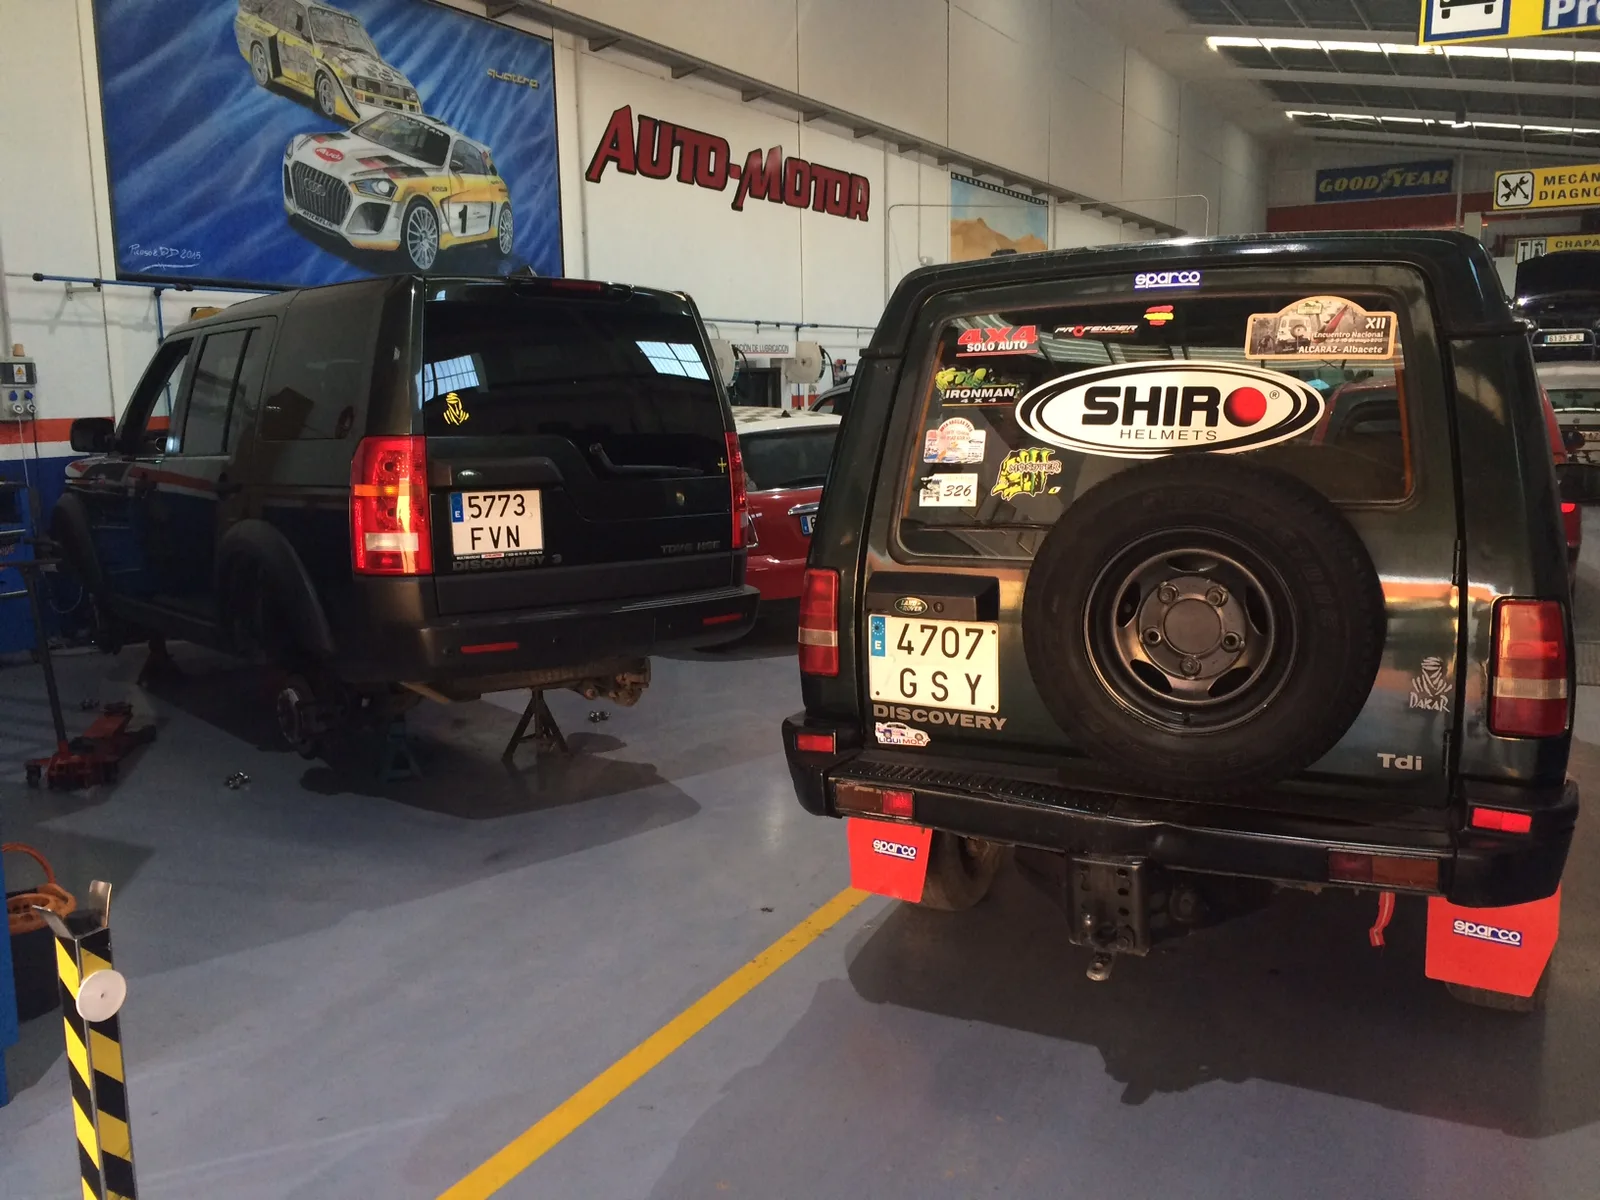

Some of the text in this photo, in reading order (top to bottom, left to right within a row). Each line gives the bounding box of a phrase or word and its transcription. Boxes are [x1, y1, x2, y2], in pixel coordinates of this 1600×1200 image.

[487, 68, 539, 88] quattro
[316, 147, 342, 161] Audi
[585, 104, 870, 222] AUTO-MOTOR
[1543, 171, 1600, 186] MECÁN
[302, 210, 334, 229] MICHELIN
[458, 204, 468, 234] 1
[1135, 271, 1200, 288] sparco
[1054, 324, 1139, 337] PROFENDER
[1365, 317, 1386, 329] XII
[957, 325, 1039, 346] 4X4
[1314, 331, 1351, 339] Encuentro
[966, 340, 1028, 352] SOLO AUTO
[1343, 345, 1383, 354] Albacete
[945, 387, 1015, 399] IRONMAN
[1081, 386, 1267, 428] SHIRO
[1120, 429, 1217, 441] HELMETS
[944, 484, 972, 497] 326
[468, 494, 525, 518] 5773
[471, 525, 520, 550] FVN
[452, 555, 545, 571] DISCOVERY
[875, 641, 882, 649] E
[897, 623, 984, 660] 4707
[873, 704, 1007, 730] DISCOVERY
[878, 736, 901, 744] LIQUI
[1377, 753, 1422, 771] Tdi
[873, 840, 916, 858] sparco
[1454, 920, 1521, 945] sparco
